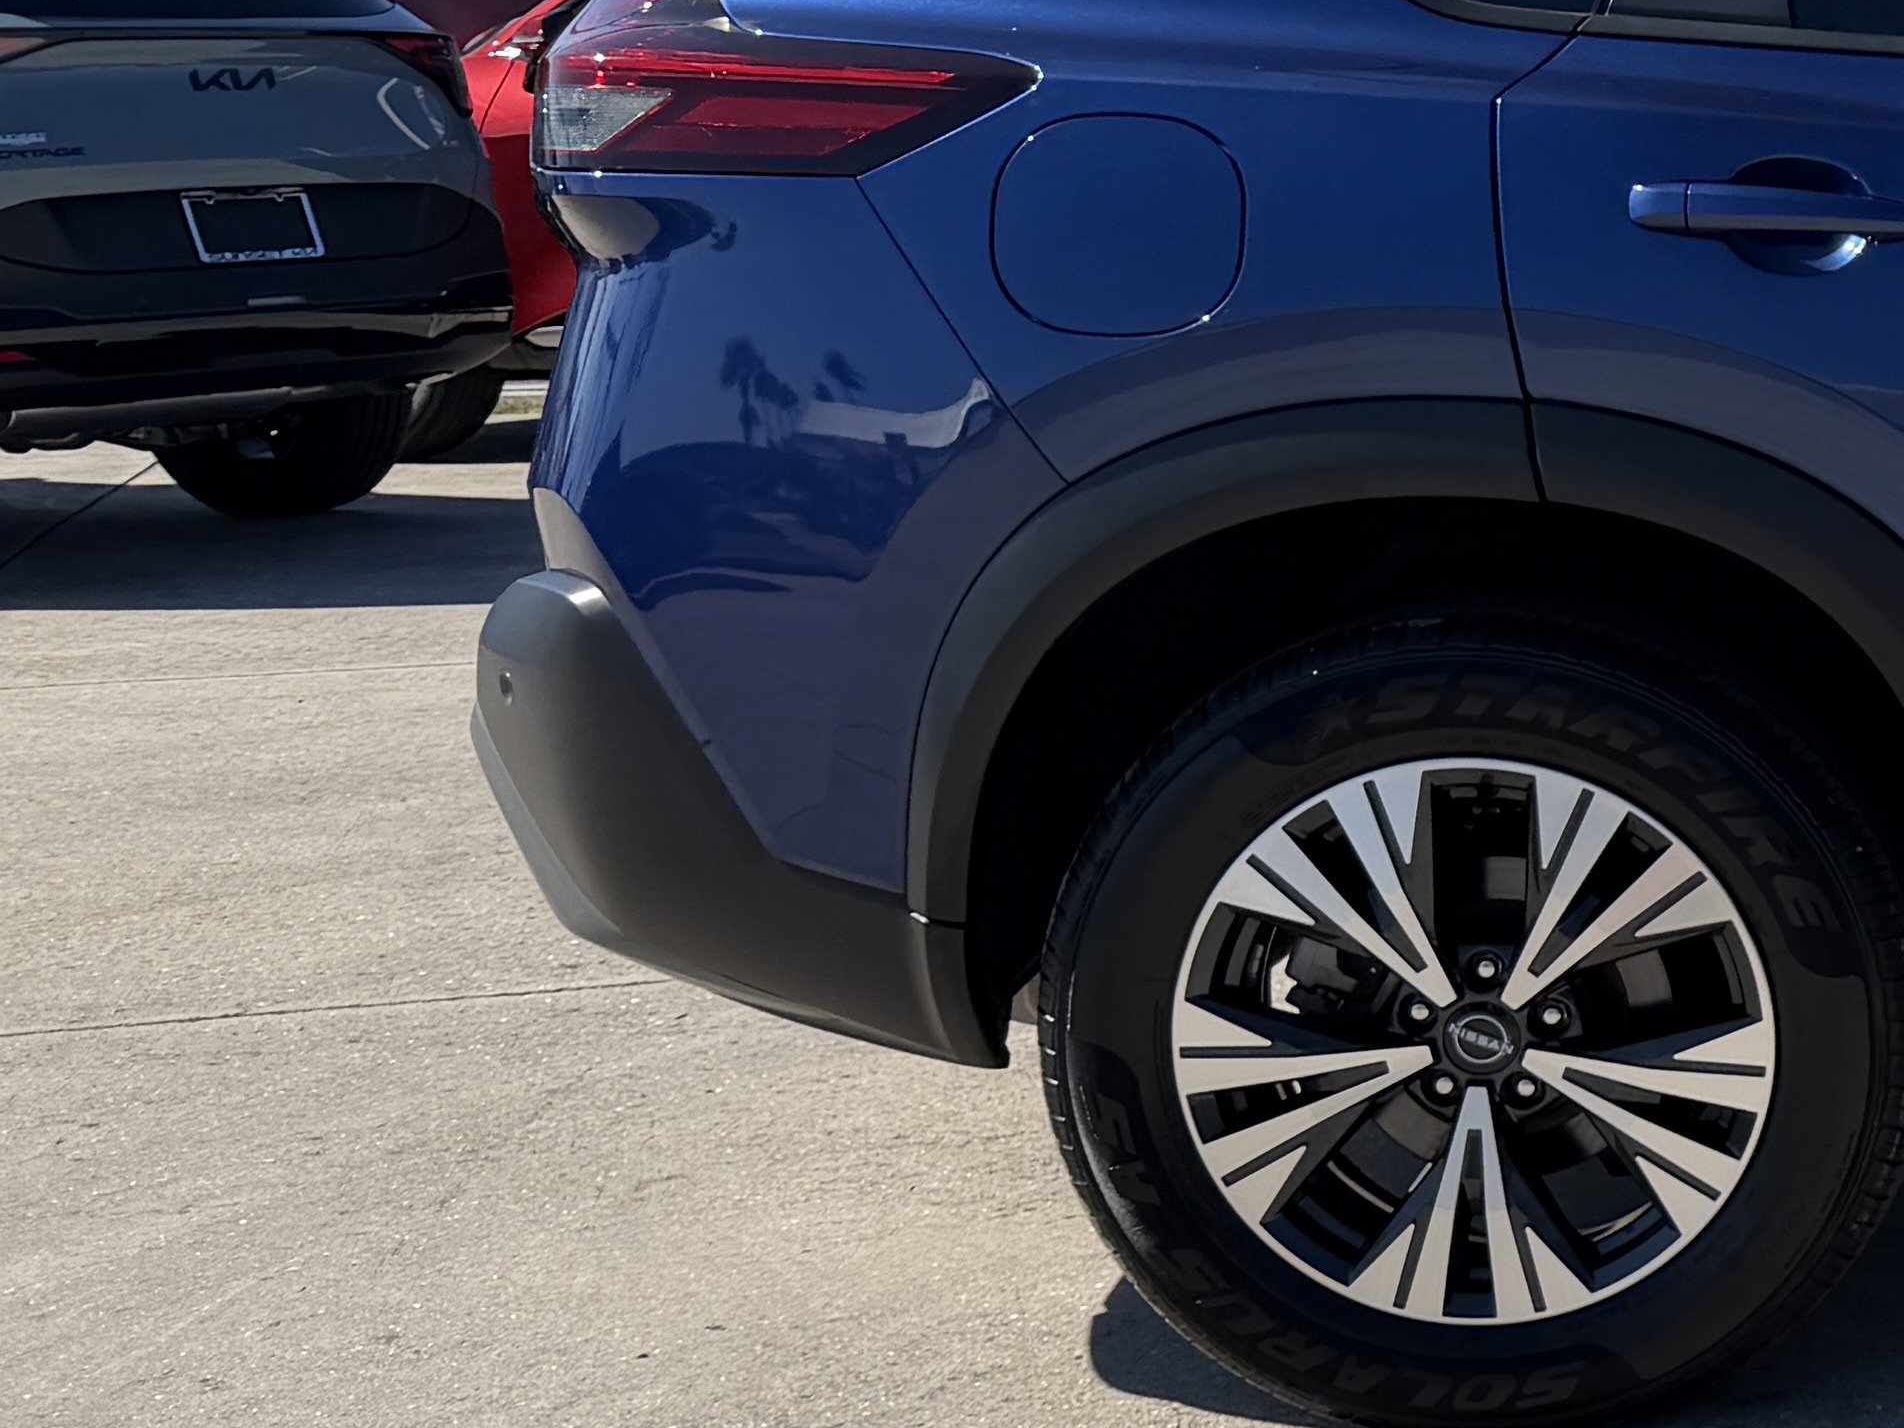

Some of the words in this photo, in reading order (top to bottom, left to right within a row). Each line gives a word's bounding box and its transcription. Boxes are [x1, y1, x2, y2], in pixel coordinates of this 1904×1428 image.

[189, 67, 276, 91] KIA
[1366, 675, 1839, 933] STARFIRE
[1448, 1022, 1514, 1056] NISSAN
[1158, 1240, 1588, 1410] SOLARUS
